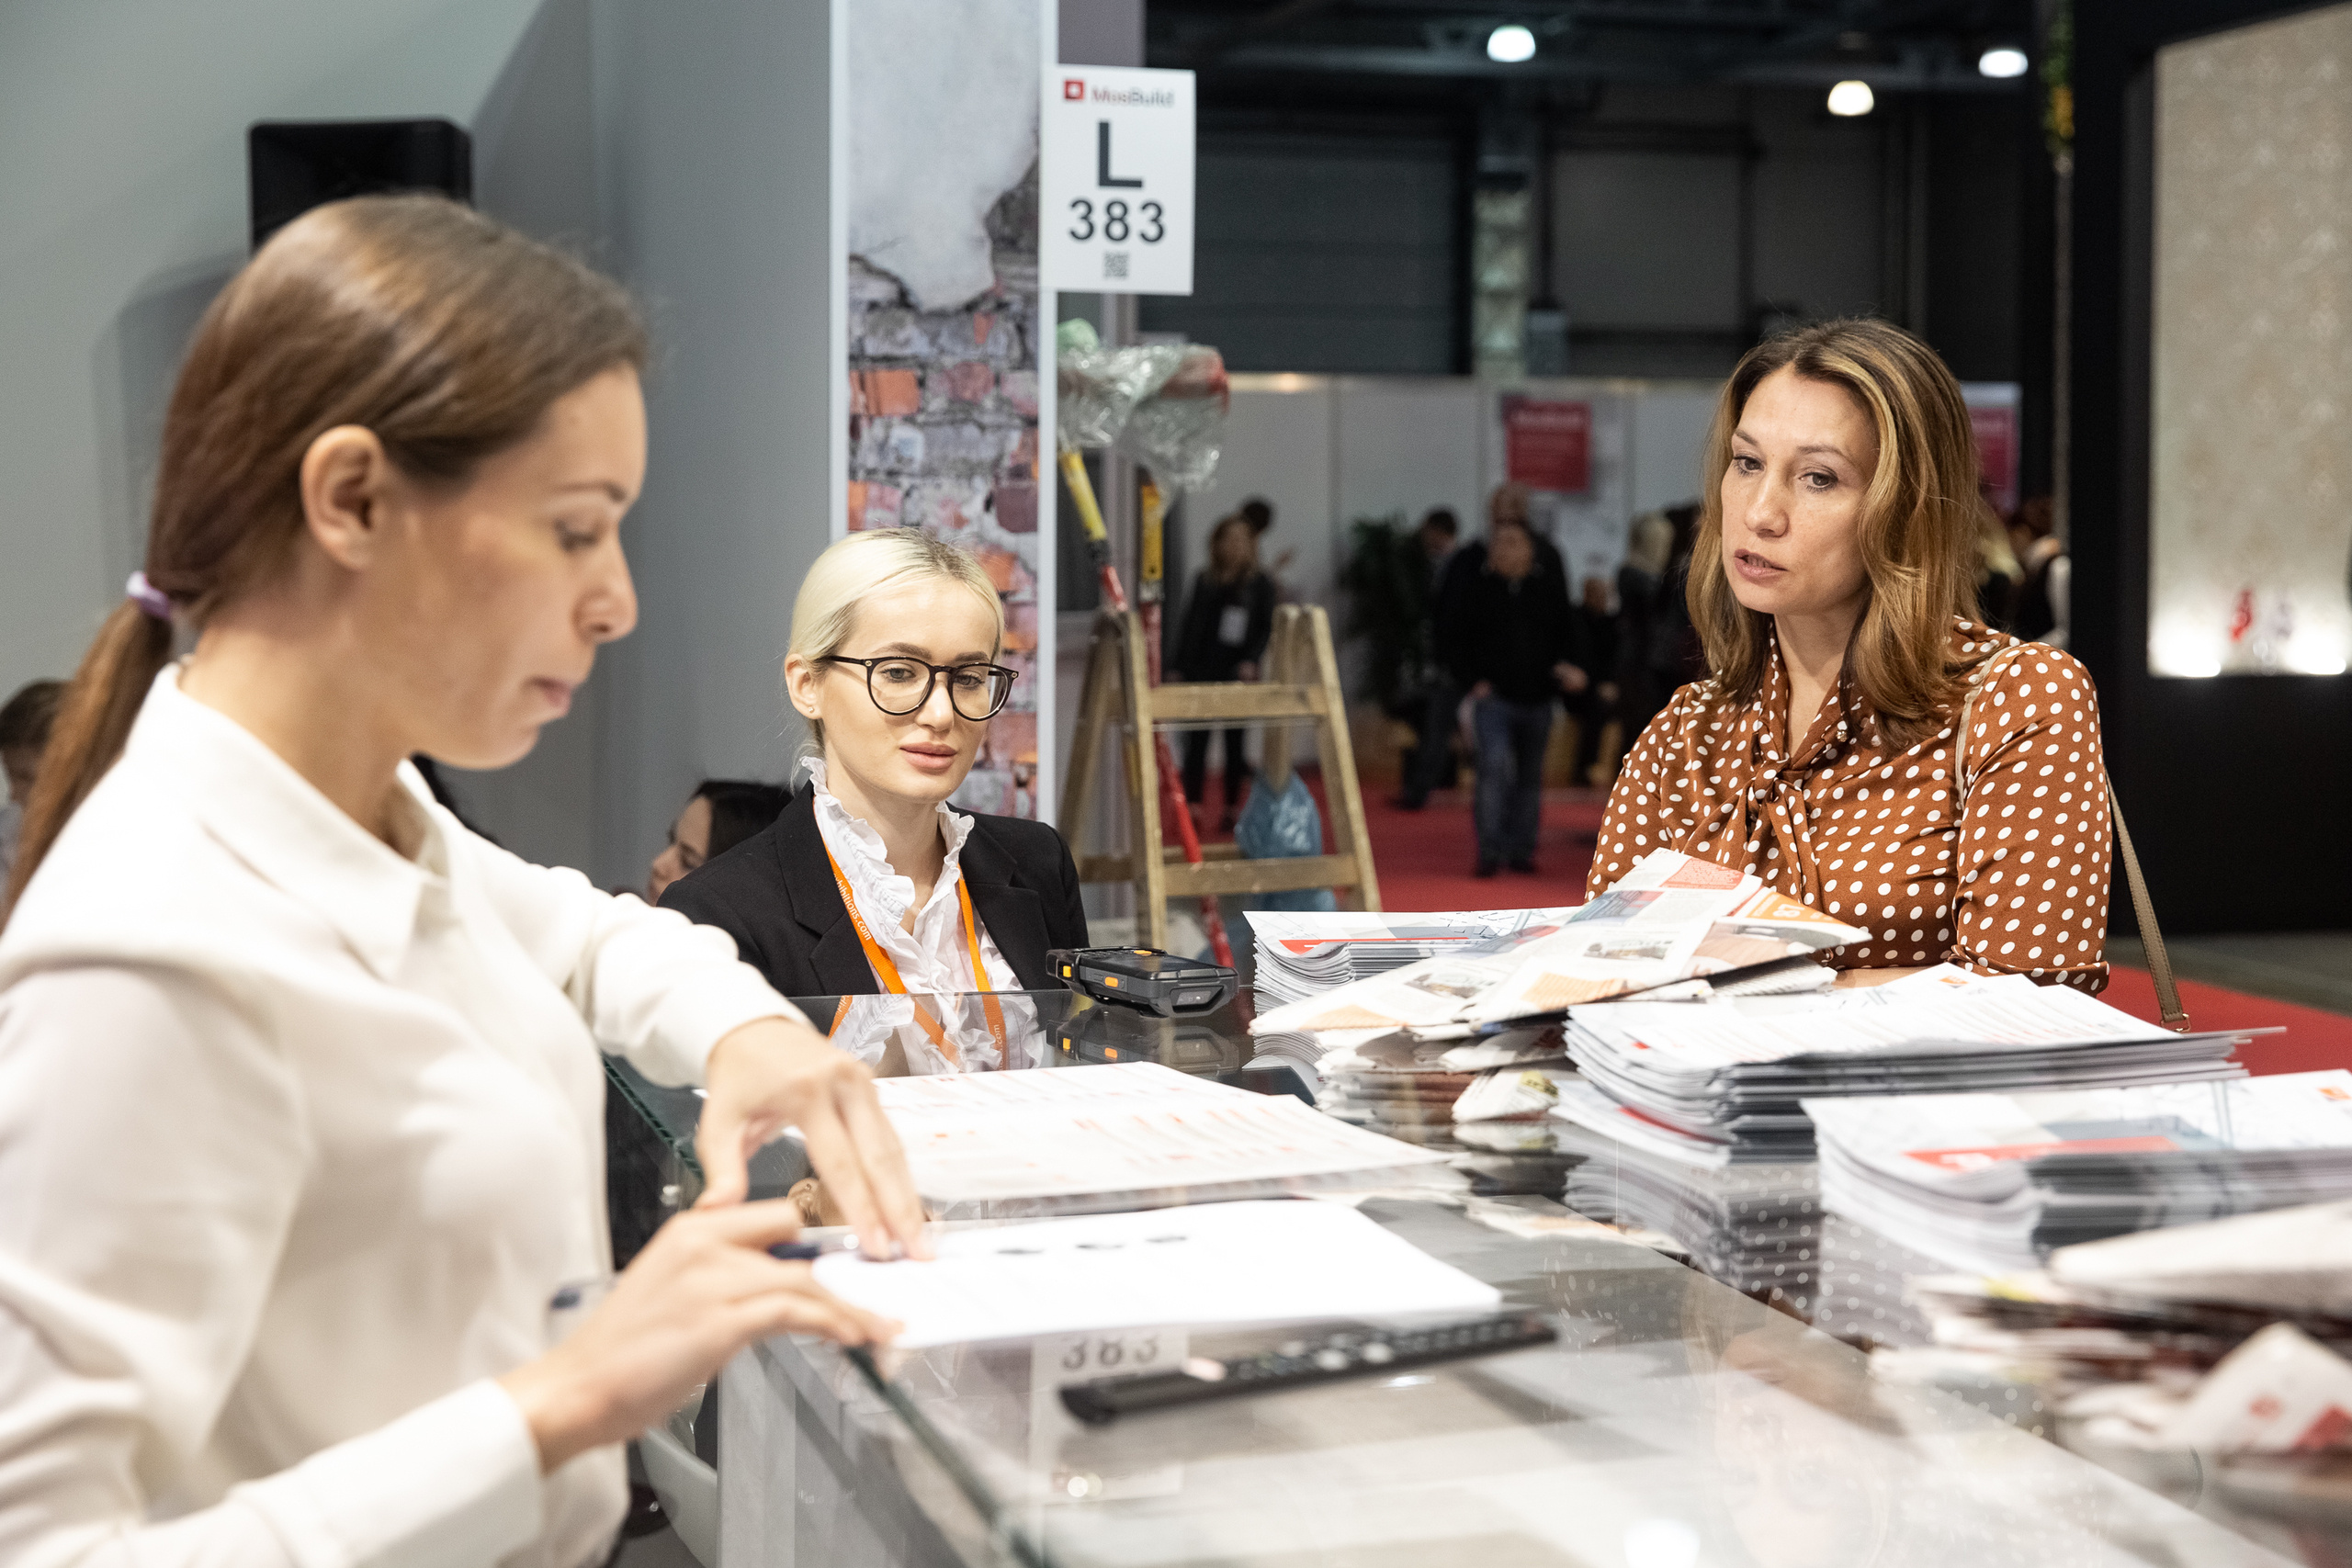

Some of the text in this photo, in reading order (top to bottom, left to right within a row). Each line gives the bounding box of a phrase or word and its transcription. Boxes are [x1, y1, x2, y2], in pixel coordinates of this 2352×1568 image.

[1091, 88, 1174, 107] MosBuild
[1098, 120, 1143, 188] L
[1069, 198, 1165, 243] 383
